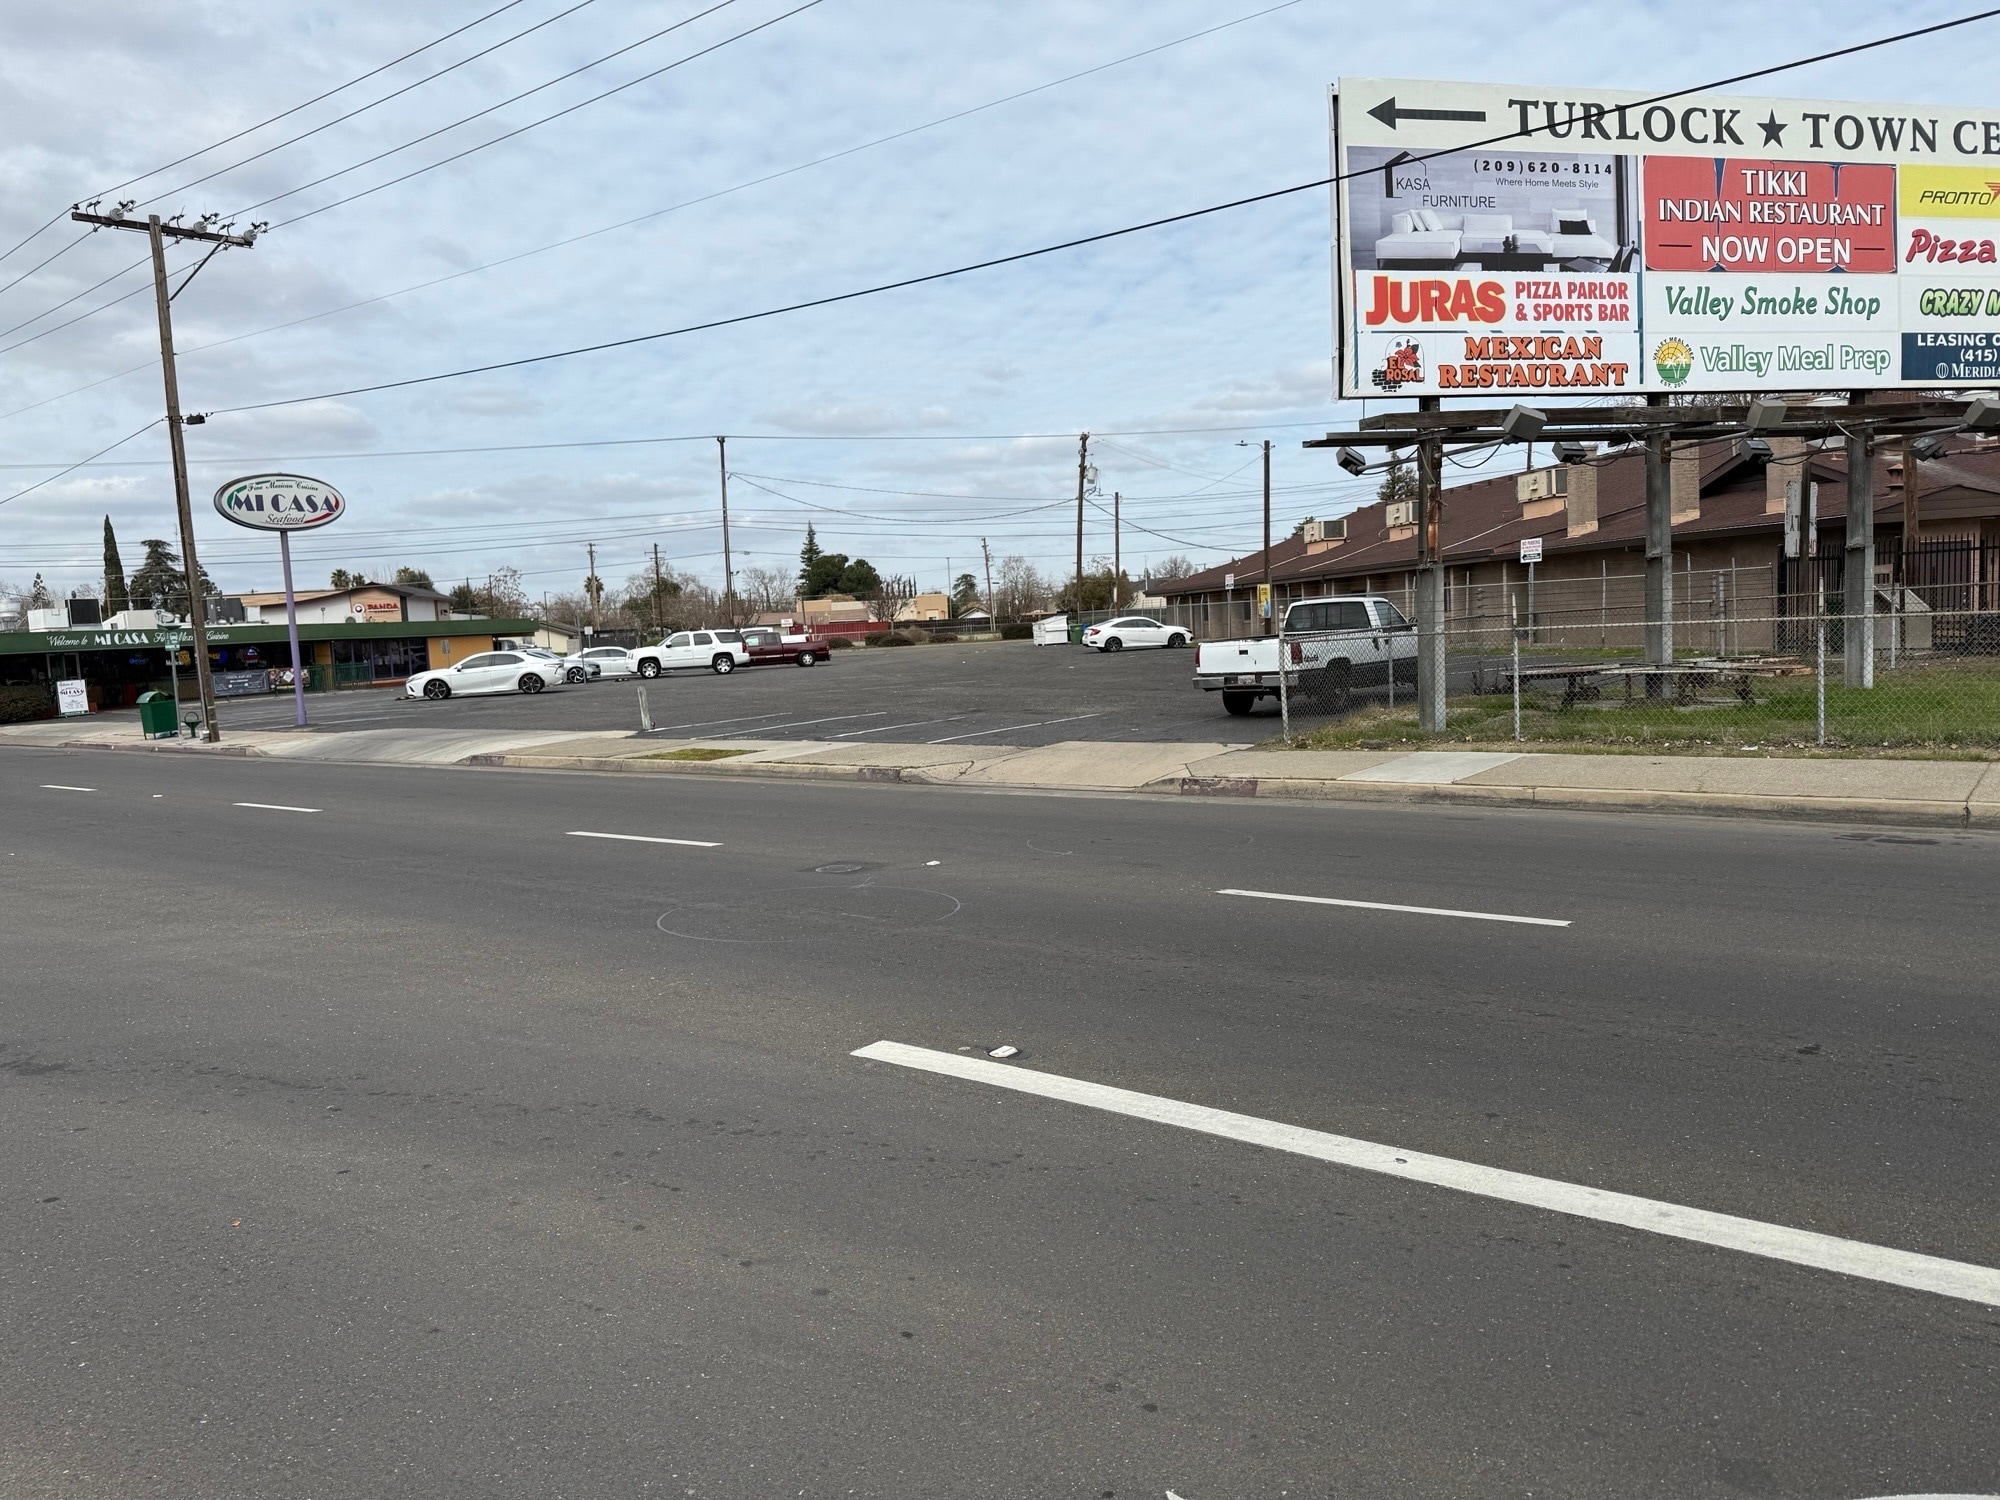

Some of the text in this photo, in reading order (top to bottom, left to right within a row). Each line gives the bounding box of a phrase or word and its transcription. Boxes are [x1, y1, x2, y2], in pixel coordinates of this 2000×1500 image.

[1507, 98, 1745, 146] TURLOCK
[1801, 112, 1939, 153] TOWN
[1474, 159, 1613, 175] (209)620-8114
[1396, 177, 1431, 191] KASA
[1495, 177, 1599, 189] Where Home Meets Style
[1741, 169, 1808, 197] TIKKI
[1422, 194, 1496, 209] FURNITURE
[1919, 190, 1992, 206] PRONTO
[1658, 198, 1886, 226] INDIAN RESTAURANT
[1701, 235, 1852, 265] NOW OPEN
[1905, 228, 1998, 264] Pizza
[1515, 281, 1629, 300] PIZZA PARLOR
[1365, 275, 1507, 326] JURAS
[1665, 285, 1881, 321] Valley Smoke Shop
[1919, 288, 1985, 318] CRAZY
[1515, 303, 1630, 322] & SPORTS BAR
[1463, 336, 1603, 361] MEXICAN
[1652, 338, 1668, 361] VALLEY
[1669, 336, 1685, 345] MEAL
[1917, 333, 1987, 347] LEASING
[1386, 355, 1406, 369] EL
[1700, 344, 1891, 378] Valley Meal Prep
[1960, 348, 1998, 363] (415)
[1384, 368, 1425, 383] ROSAL
[1438, 362, 1629, 388] RESTAURANT
[247, 480, 319, 492] Fine Mexican Cuisine
[231, 492, 337, 513] MI CASA
[265, 513, 306, 525] Seafood
[46, 634, 80, 647] Welcome
[81, 634, 88, 646] to
[94, 633, 112, 646] MI
[113, 632, 150, 646] CASA
[206, 630, 230, 641] Cuisine
